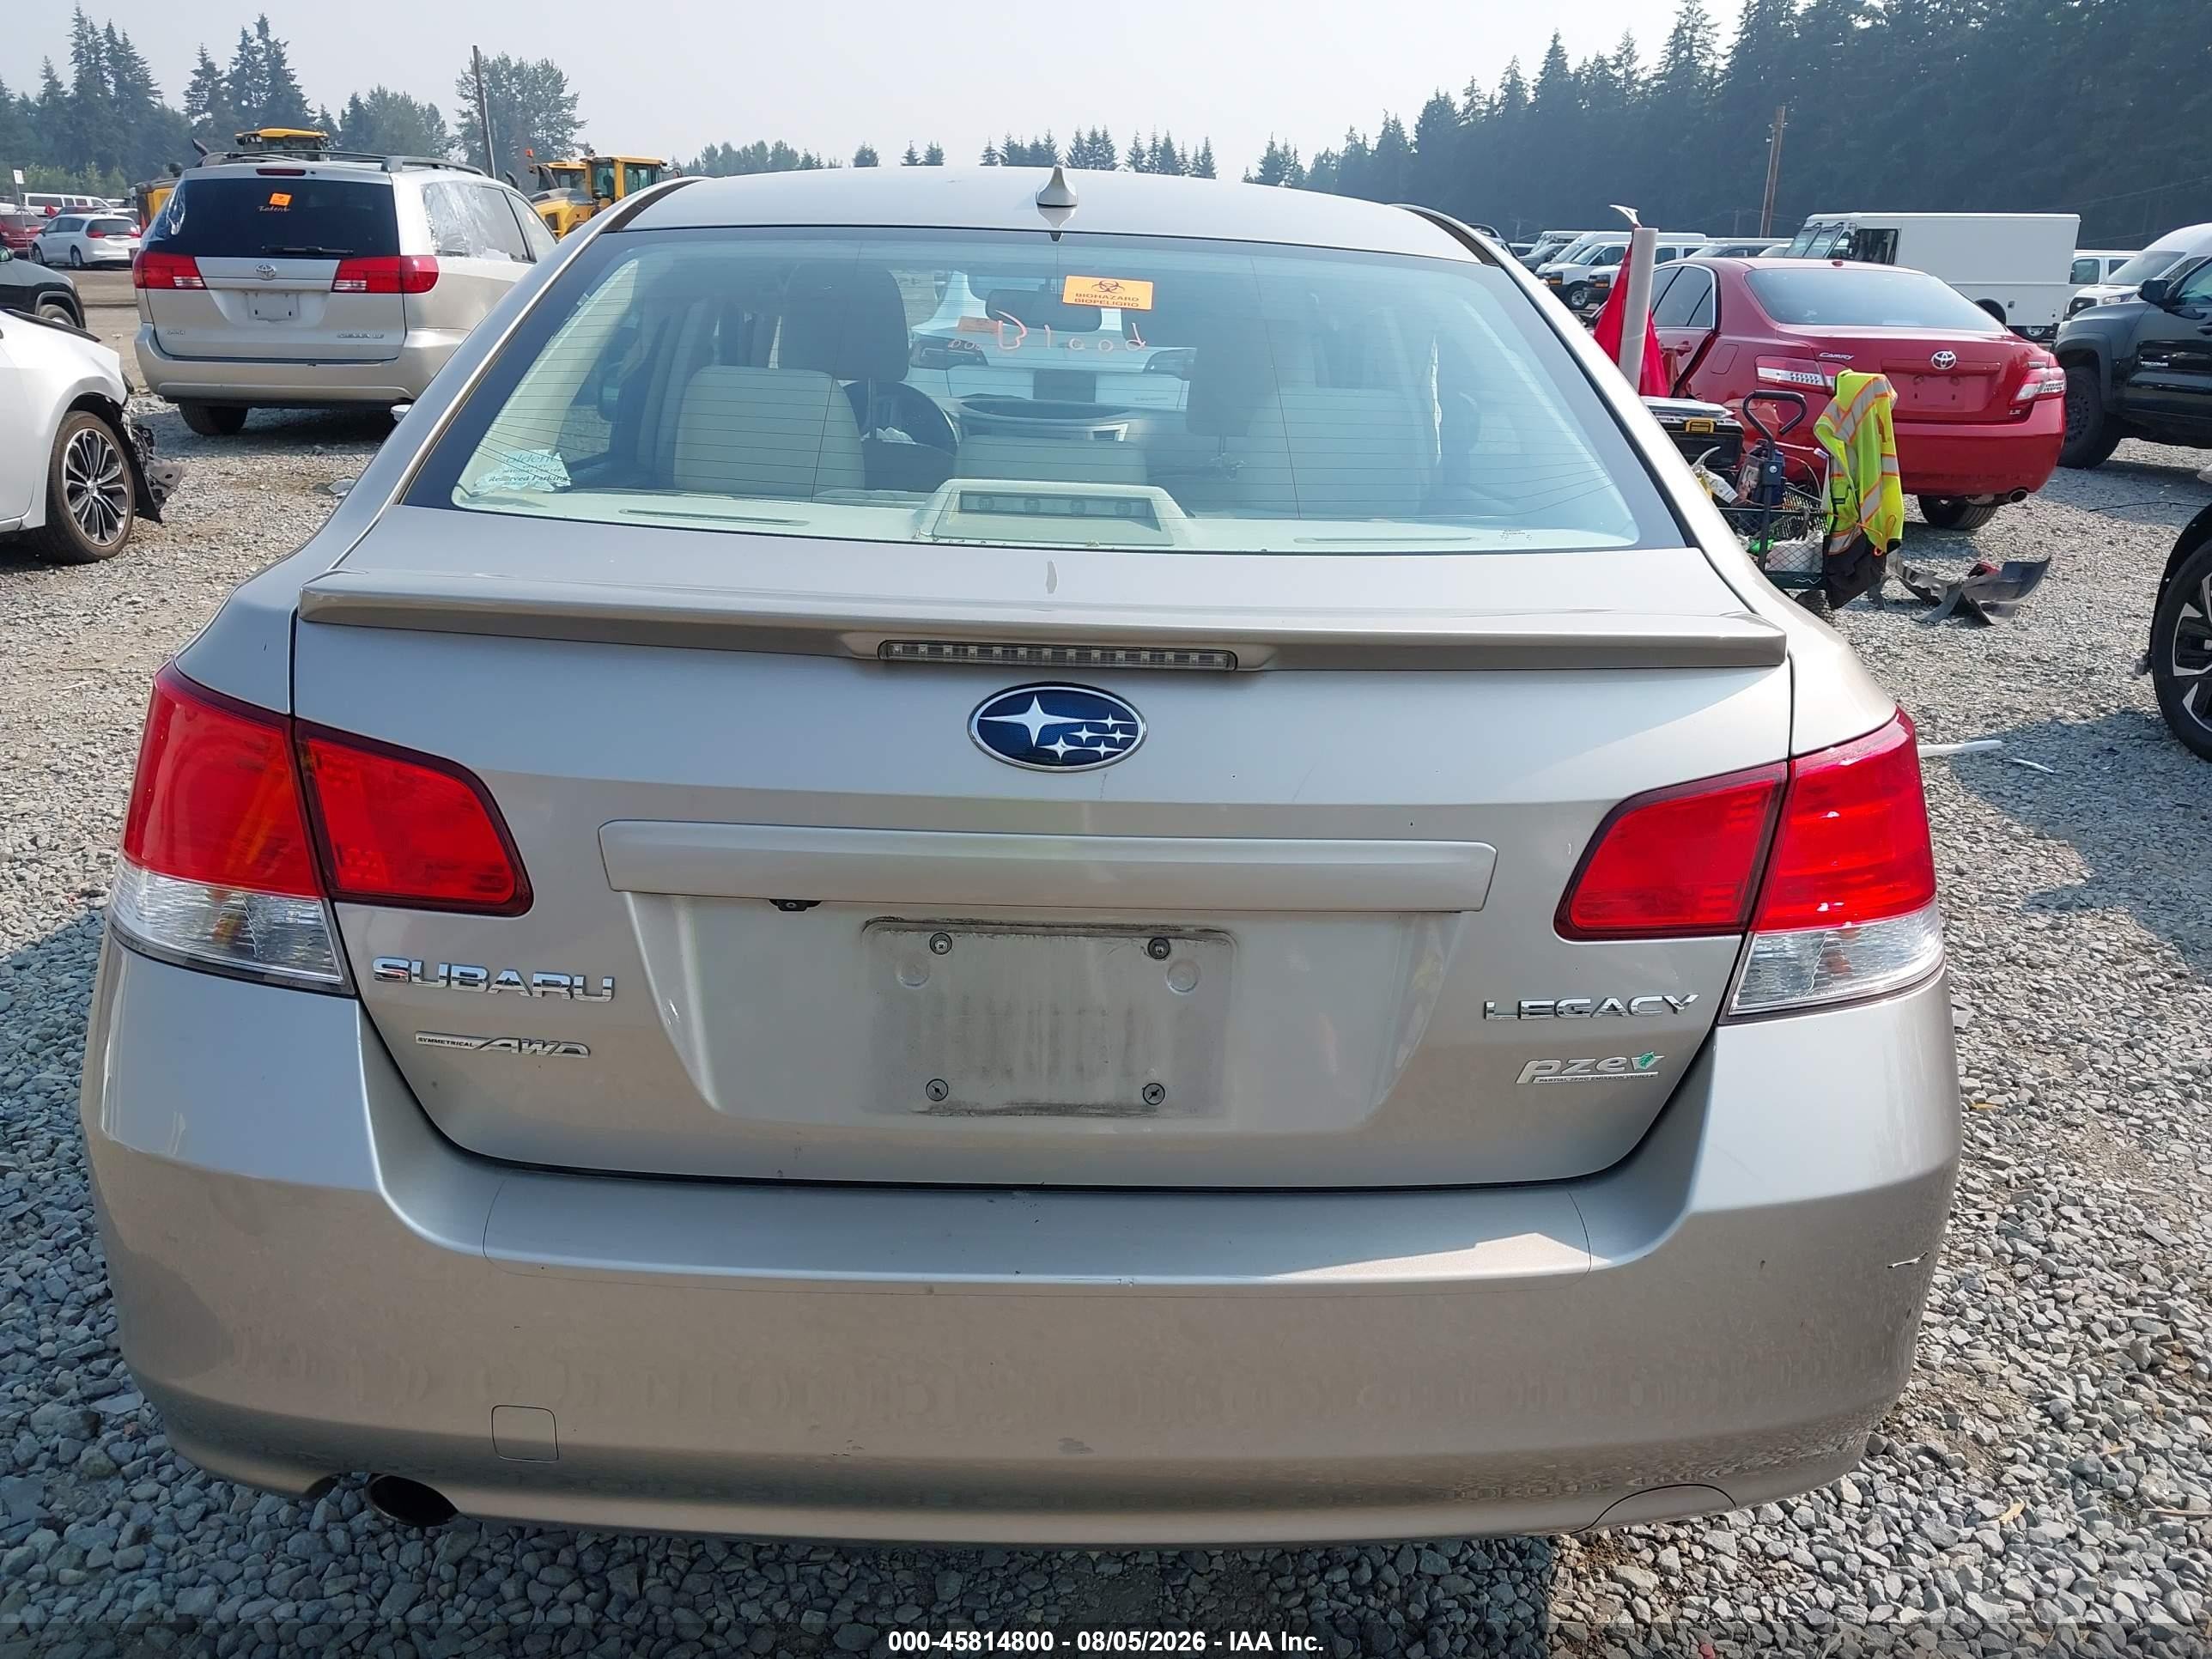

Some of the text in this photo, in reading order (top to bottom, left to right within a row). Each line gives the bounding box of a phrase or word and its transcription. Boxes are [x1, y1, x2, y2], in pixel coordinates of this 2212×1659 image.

[1074, 298, 1139, 308] BIOPELIGRO
[1075, 292, 1139, 302] BIOHAZARD
[996, 309, 1146, 350] Blood
[373, 957, 615, 1003] SUBARU
[1484, 994, 1699, 1020] LEGACY
[417, 1036, 591, 1059] SYMMETRICAL AWD
